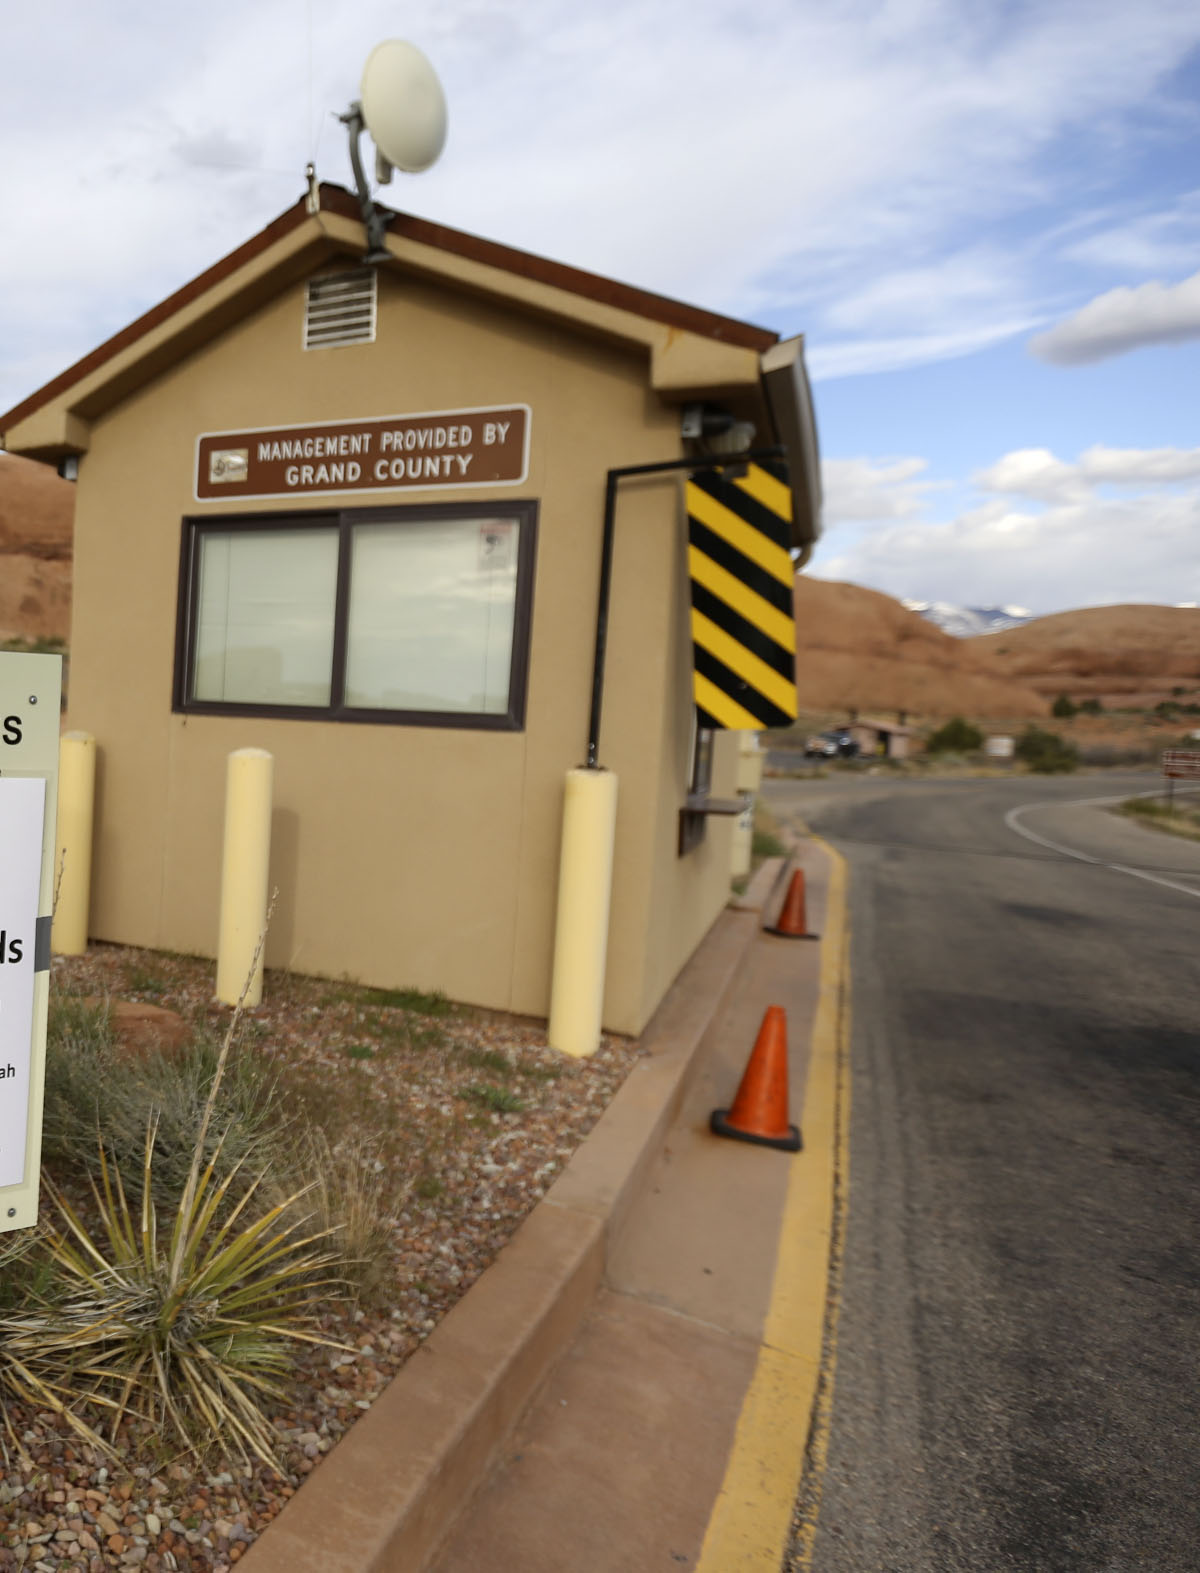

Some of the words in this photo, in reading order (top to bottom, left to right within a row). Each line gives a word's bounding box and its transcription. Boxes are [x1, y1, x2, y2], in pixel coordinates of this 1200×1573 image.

[258, 434, 372, 460] MANAGEMENT
[380, 426, 472, 450] PROVIDED
[482, 422, 510, 445] BY
[285, 462, 361, 485] GRAND
[374, 454, 472, 479] COUNTY
